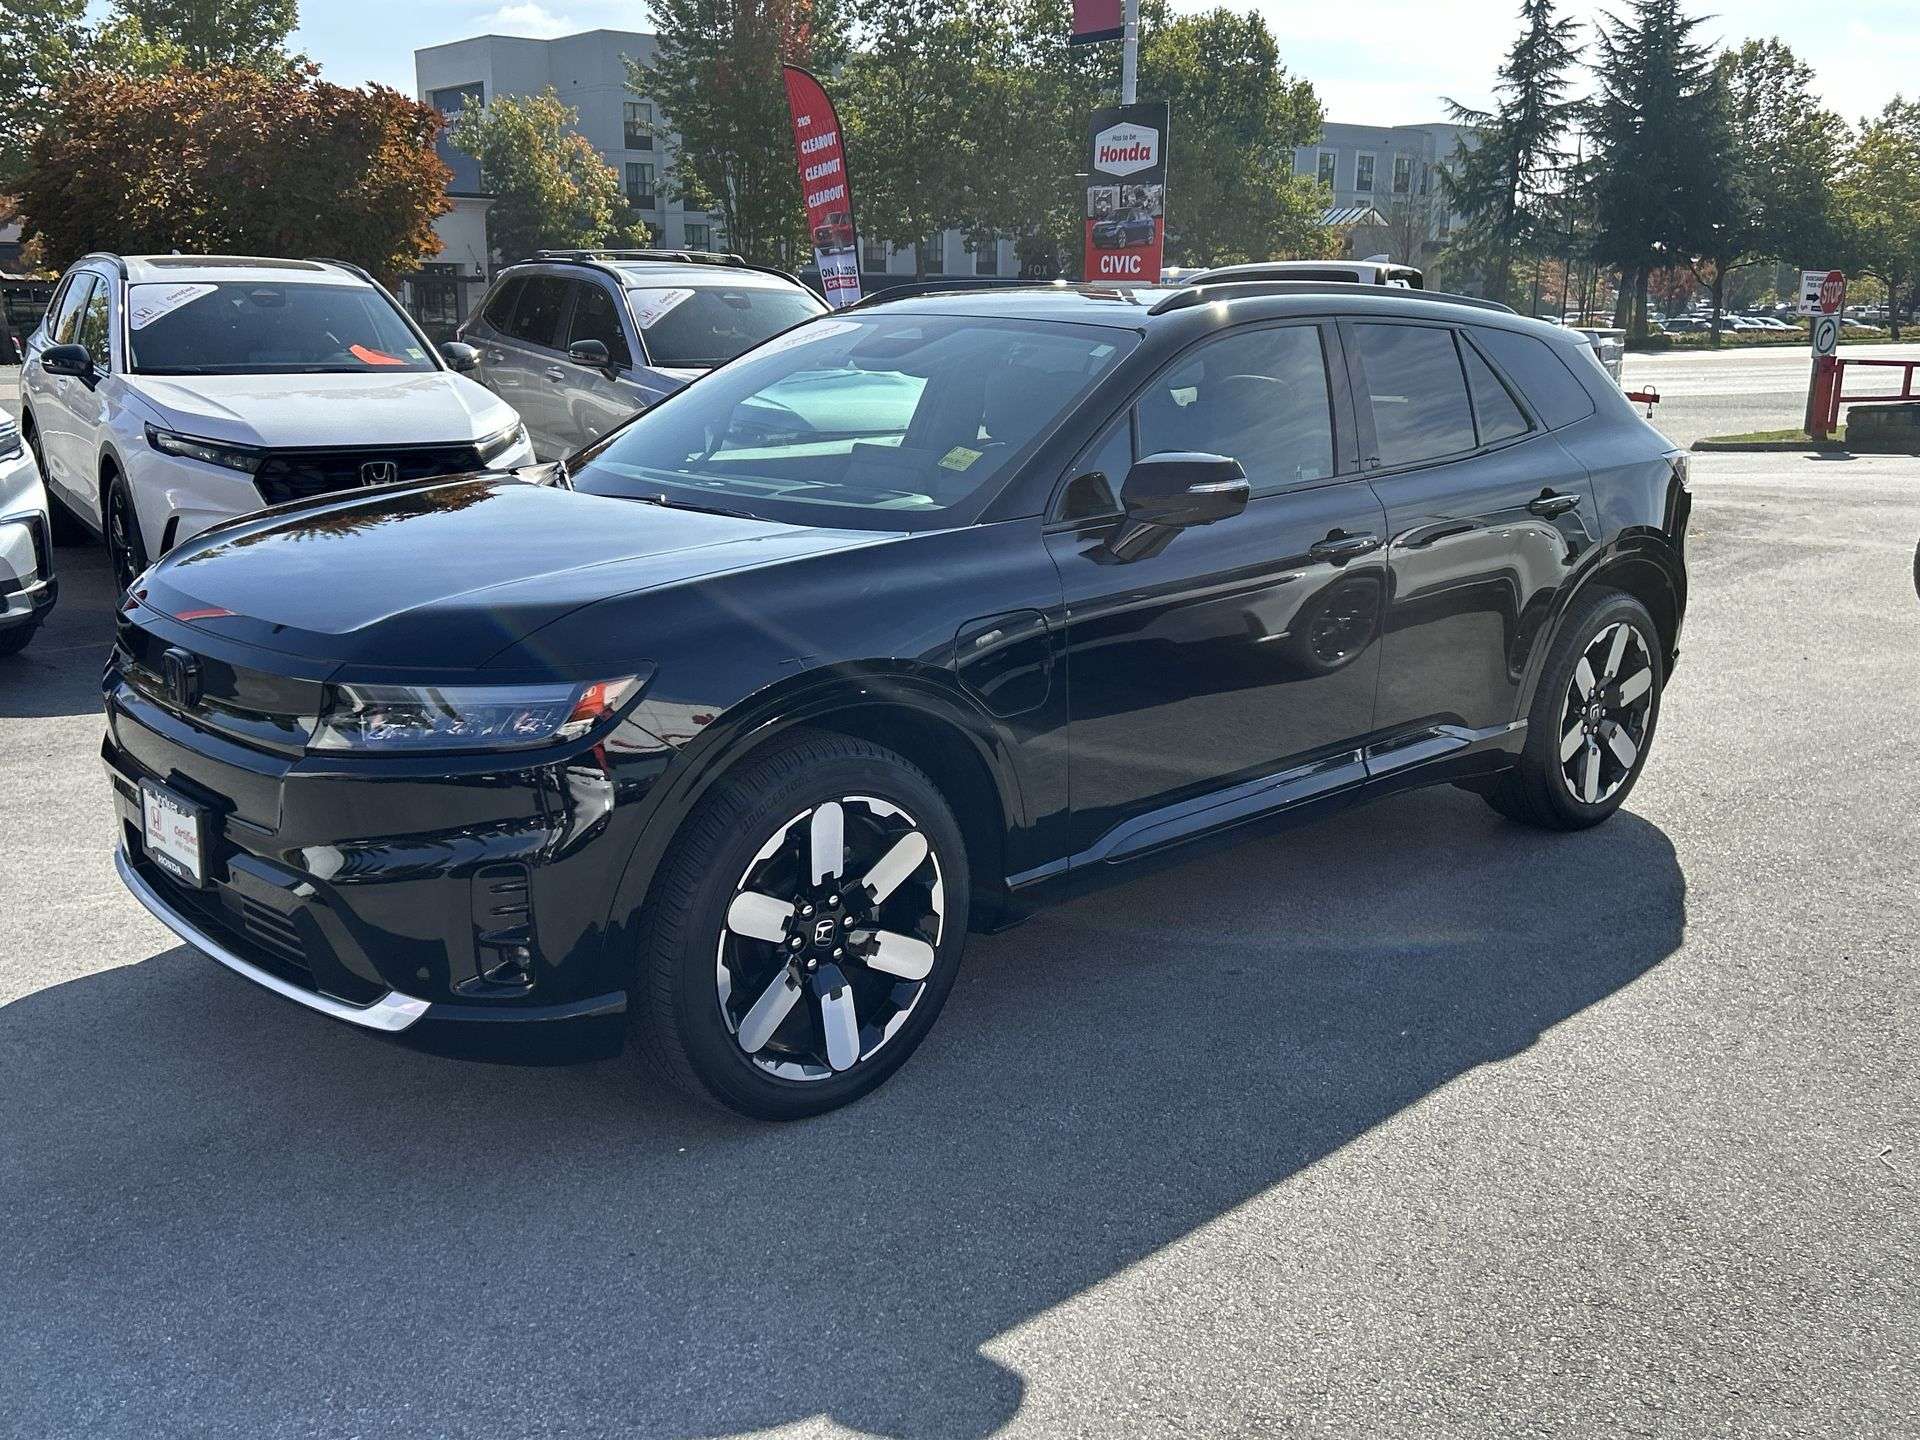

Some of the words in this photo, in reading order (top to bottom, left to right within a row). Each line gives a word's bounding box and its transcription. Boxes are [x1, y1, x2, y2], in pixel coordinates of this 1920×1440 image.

[801, 132, 837, 154] CLEAROUT
[1099, 142, 1152, 163] Honda
[805, 158, 841, 181] CLEAROUT
[808, 185, 845, 208] CLEAROUT
[821, 266, 835, 277] ON
[1100, 255, 1142, 273] CIVIC
[1821, 281, 1844, 304] STOP
[157, 854, 182, 876] HONDA
